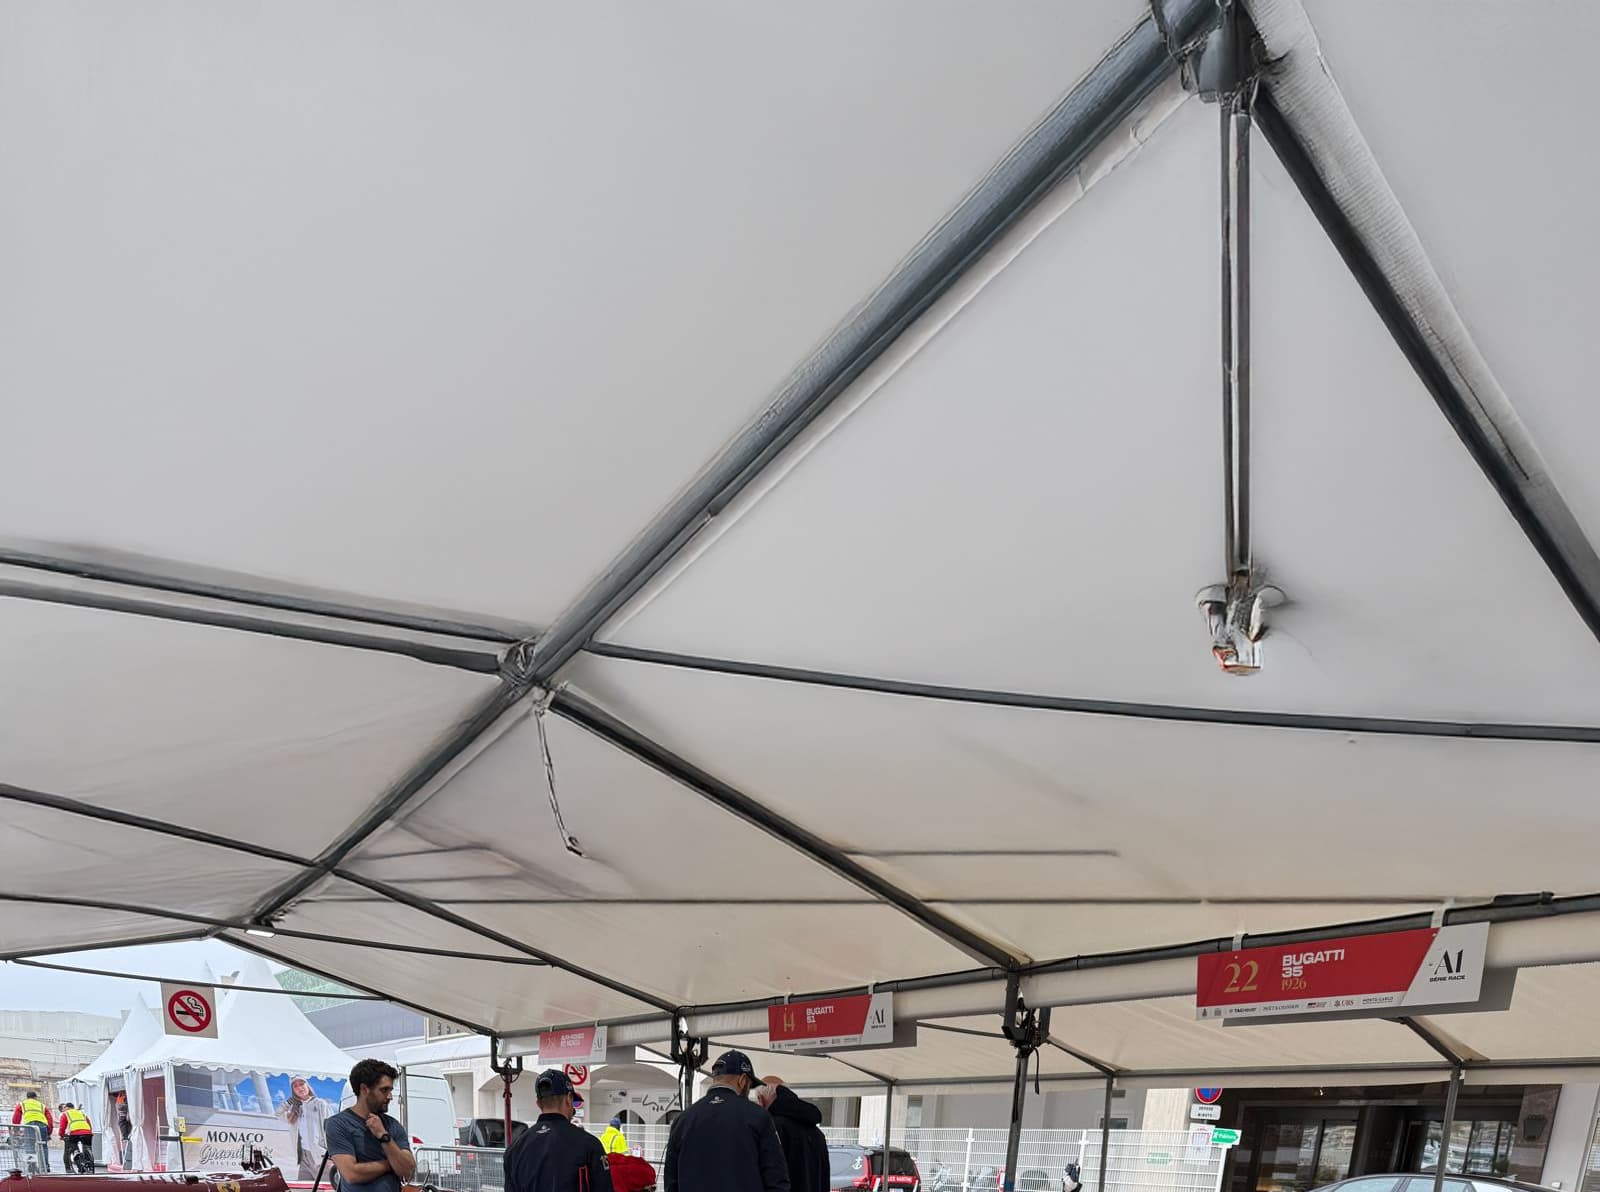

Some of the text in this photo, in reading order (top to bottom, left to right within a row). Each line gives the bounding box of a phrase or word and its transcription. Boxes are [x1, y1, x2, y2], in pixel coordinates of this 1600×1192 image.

[1281, 949, 1345, 967] BUGATTI
[1223, 960, 1259, 993] 22
[1281, 965, 1304, 978] 35
[1280, 977, 1307, 992] 1926
[806, 1005, 834, 1017] BUGATTI
[206, 1130, 264, 1143] MONACO
